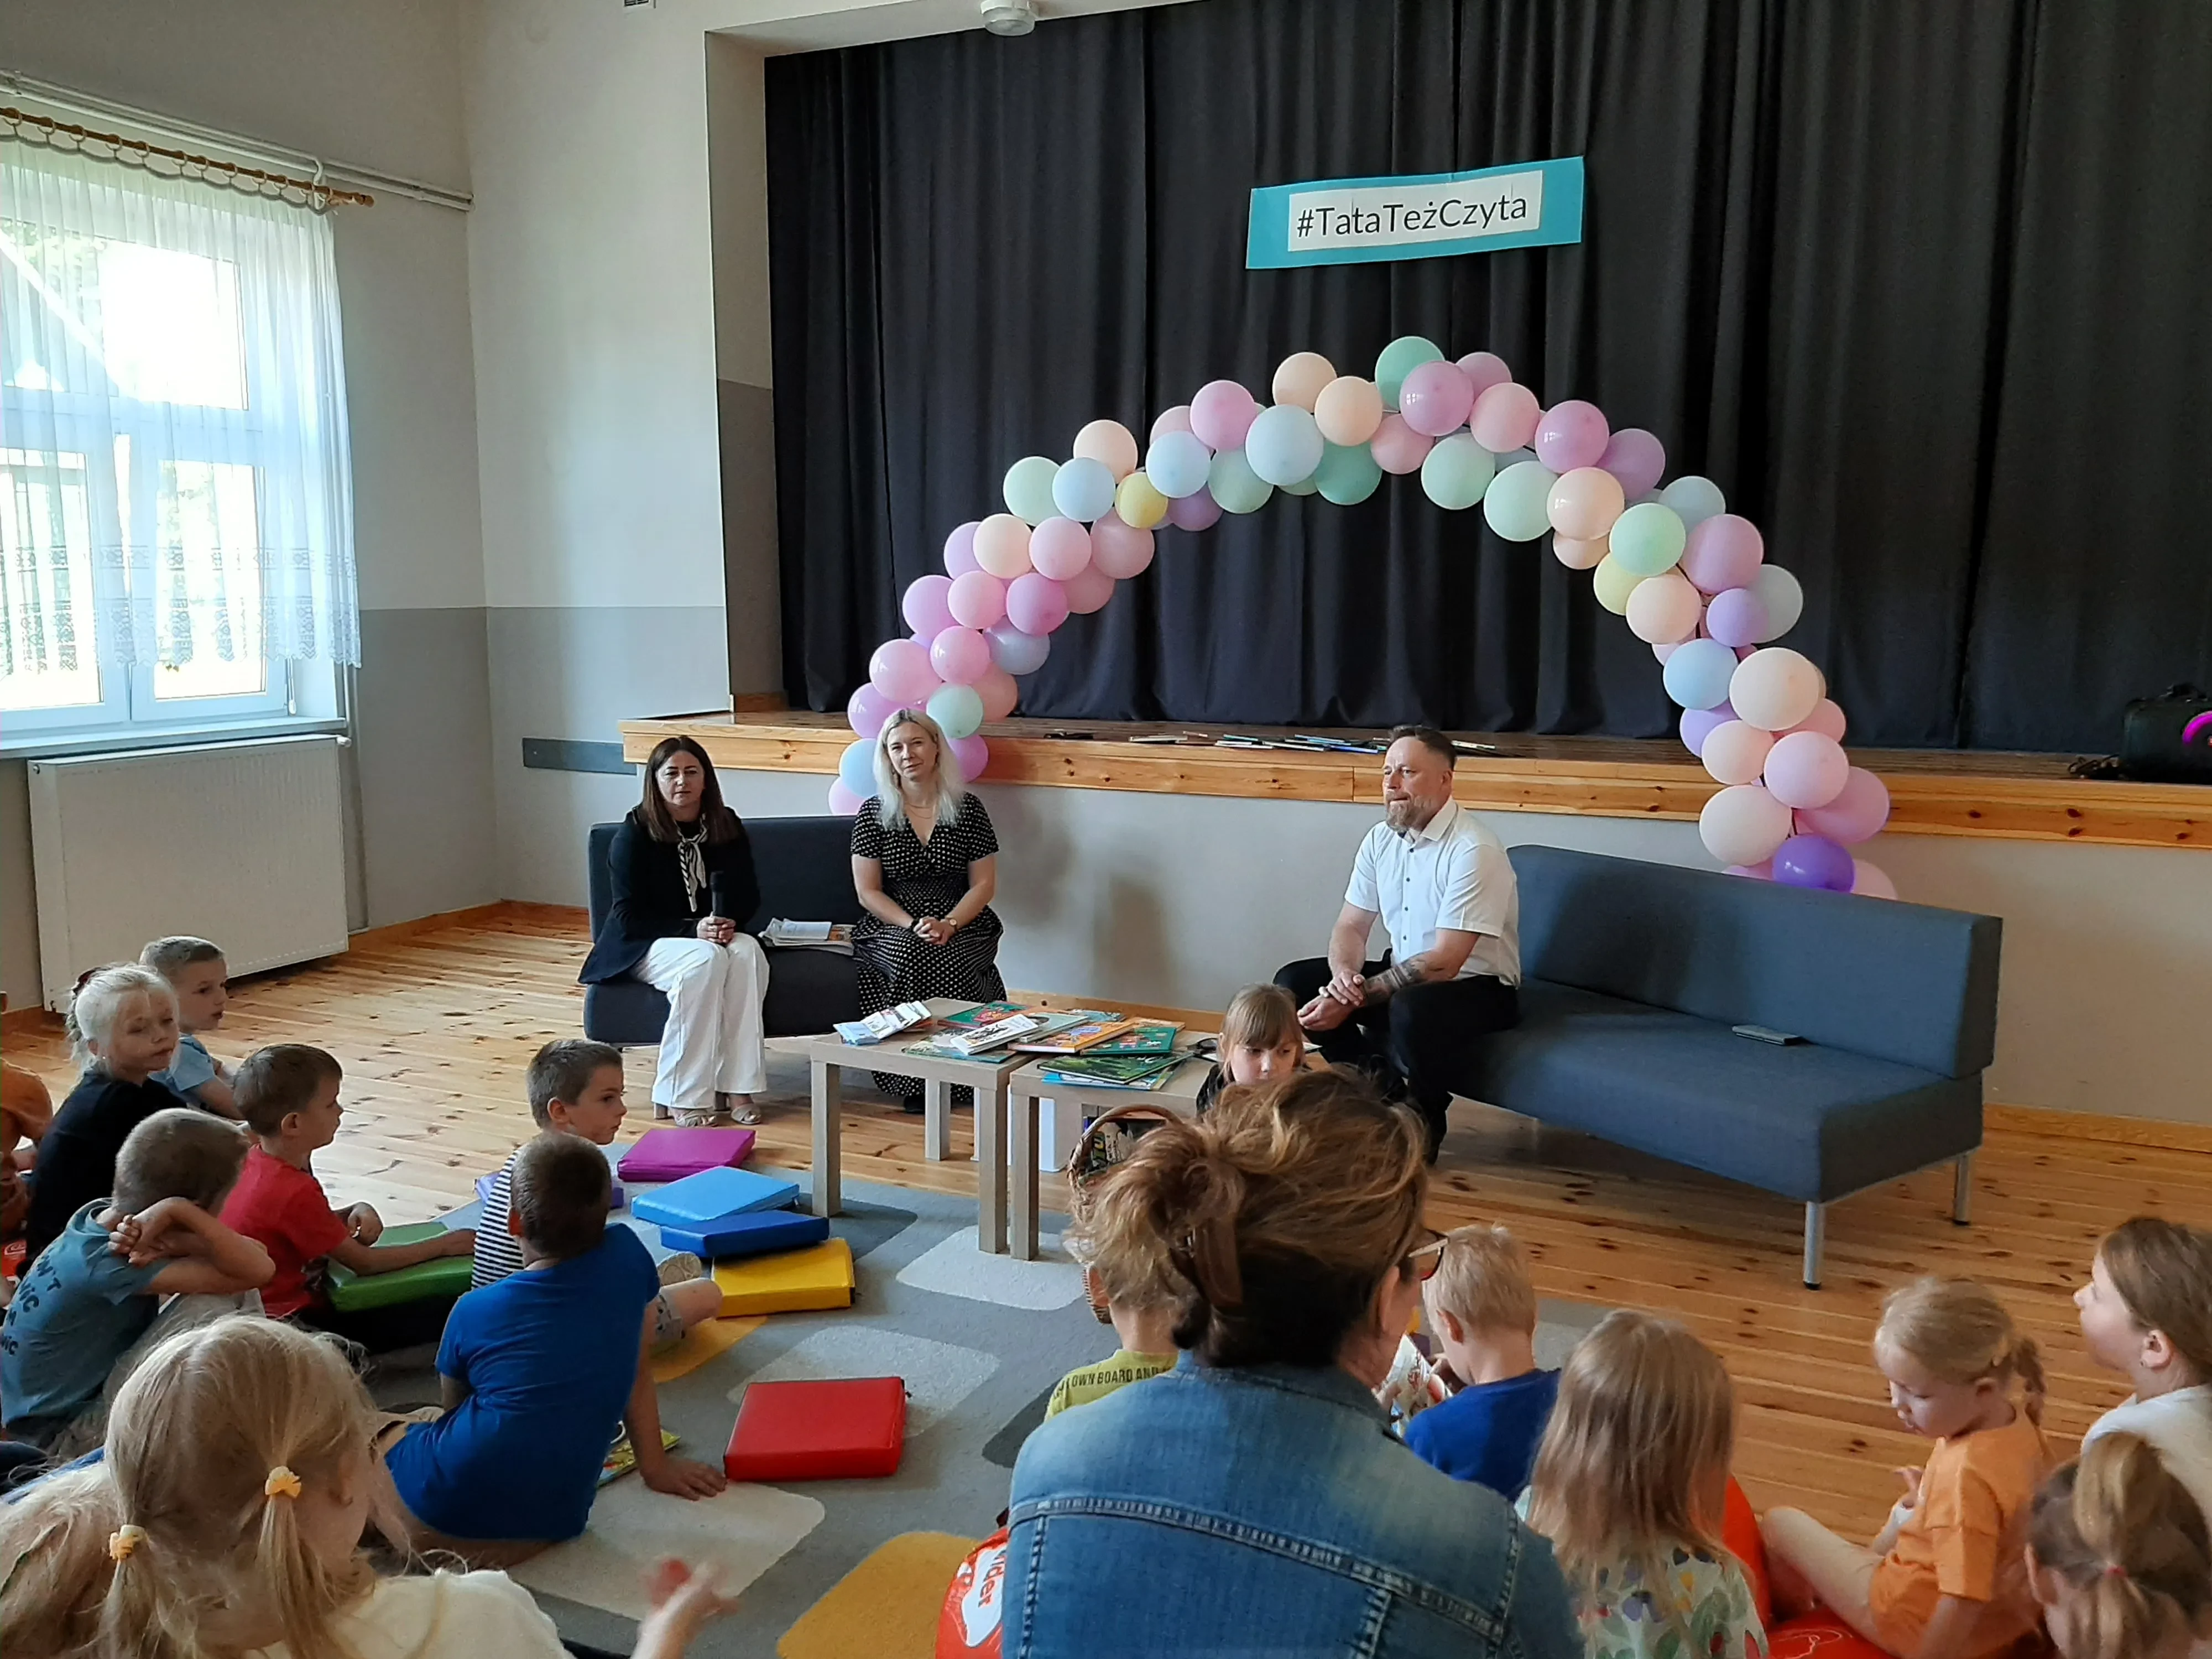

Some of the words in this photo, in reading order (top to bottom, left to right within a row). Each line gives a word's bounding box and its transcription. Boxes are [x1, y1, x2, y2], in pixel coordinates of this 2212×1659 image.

[1297, 194, 1527, 237] #TataTeżCzyta
[1072, 1373, 1095, 1387] OWN
[1097, 1369, 1133, 1385] BOARD
